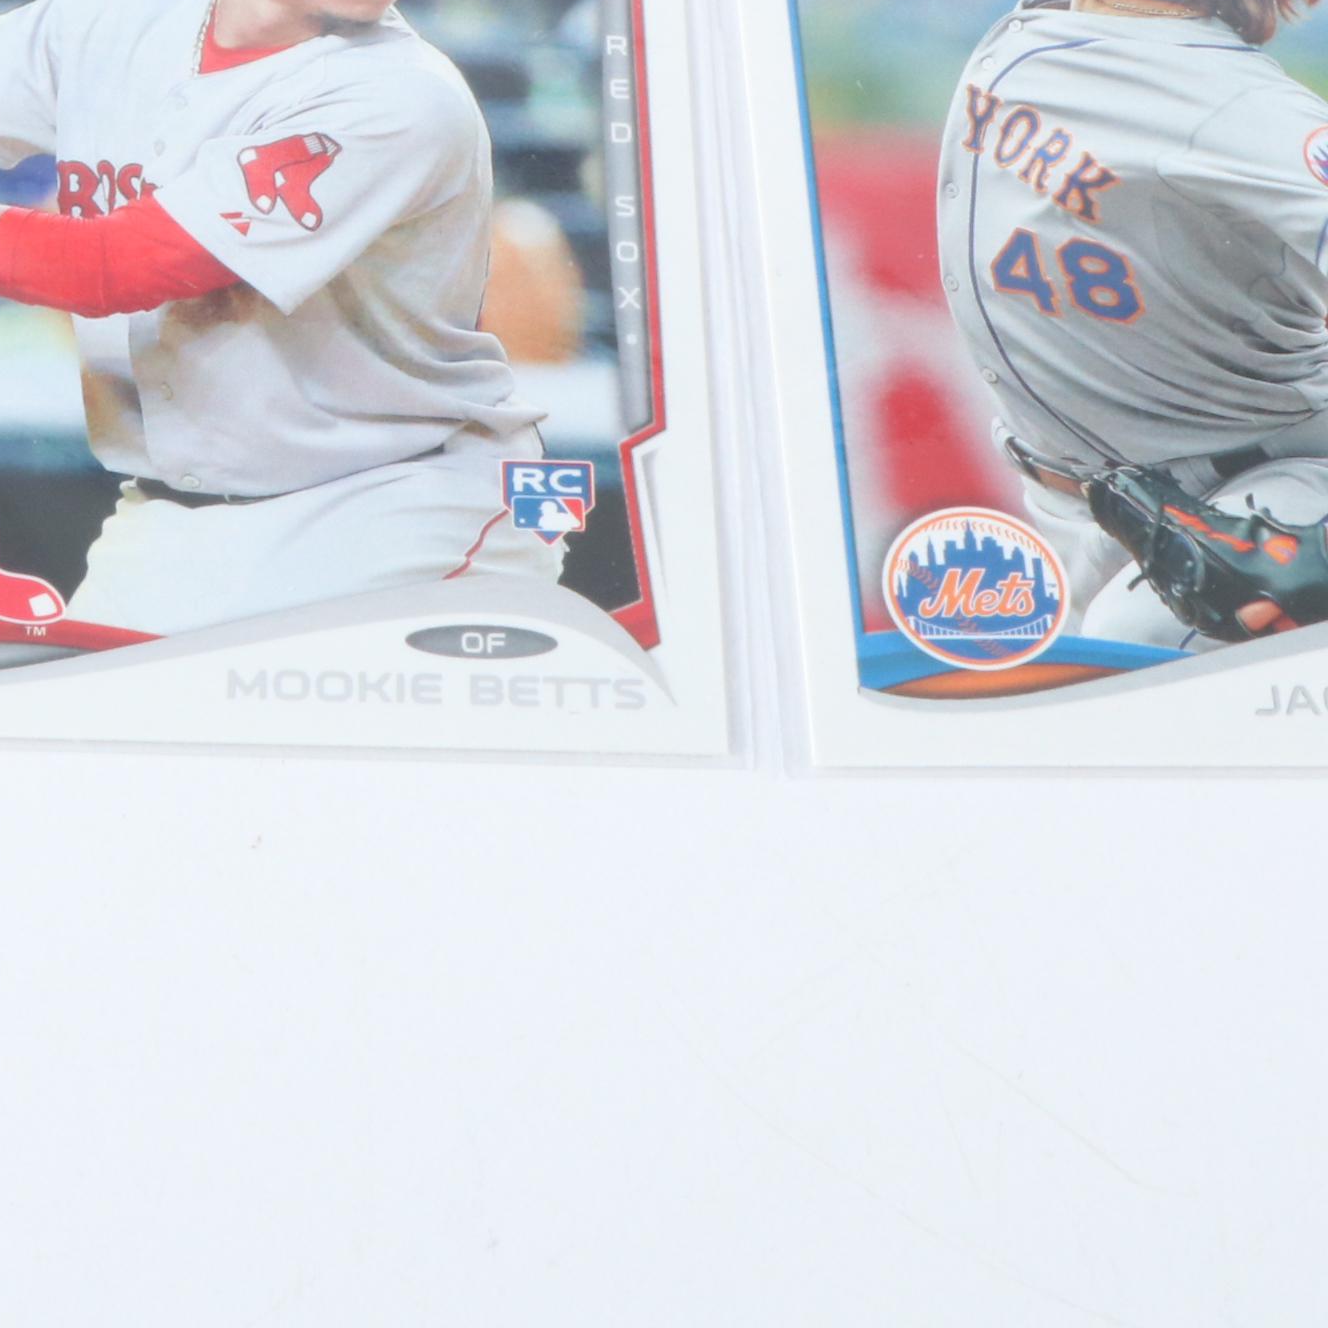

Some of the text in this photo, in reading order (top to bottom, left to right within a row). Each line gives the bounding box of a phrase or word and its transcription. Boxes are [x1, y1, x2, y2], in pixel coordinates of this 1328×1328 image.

[605, 35, 641, 311] RED SOX
[962, 83, 1122, 224] YORK
[990, 227, 1145, 325] 48
[511, 467, 584, 494] RC
[919, 568, 1037, 618] Mets
[460, 631, 506, 654] OF
[226, 668, 648, 710] MOOKIE BETTS
[1255, 684, 1328, 716] JA
